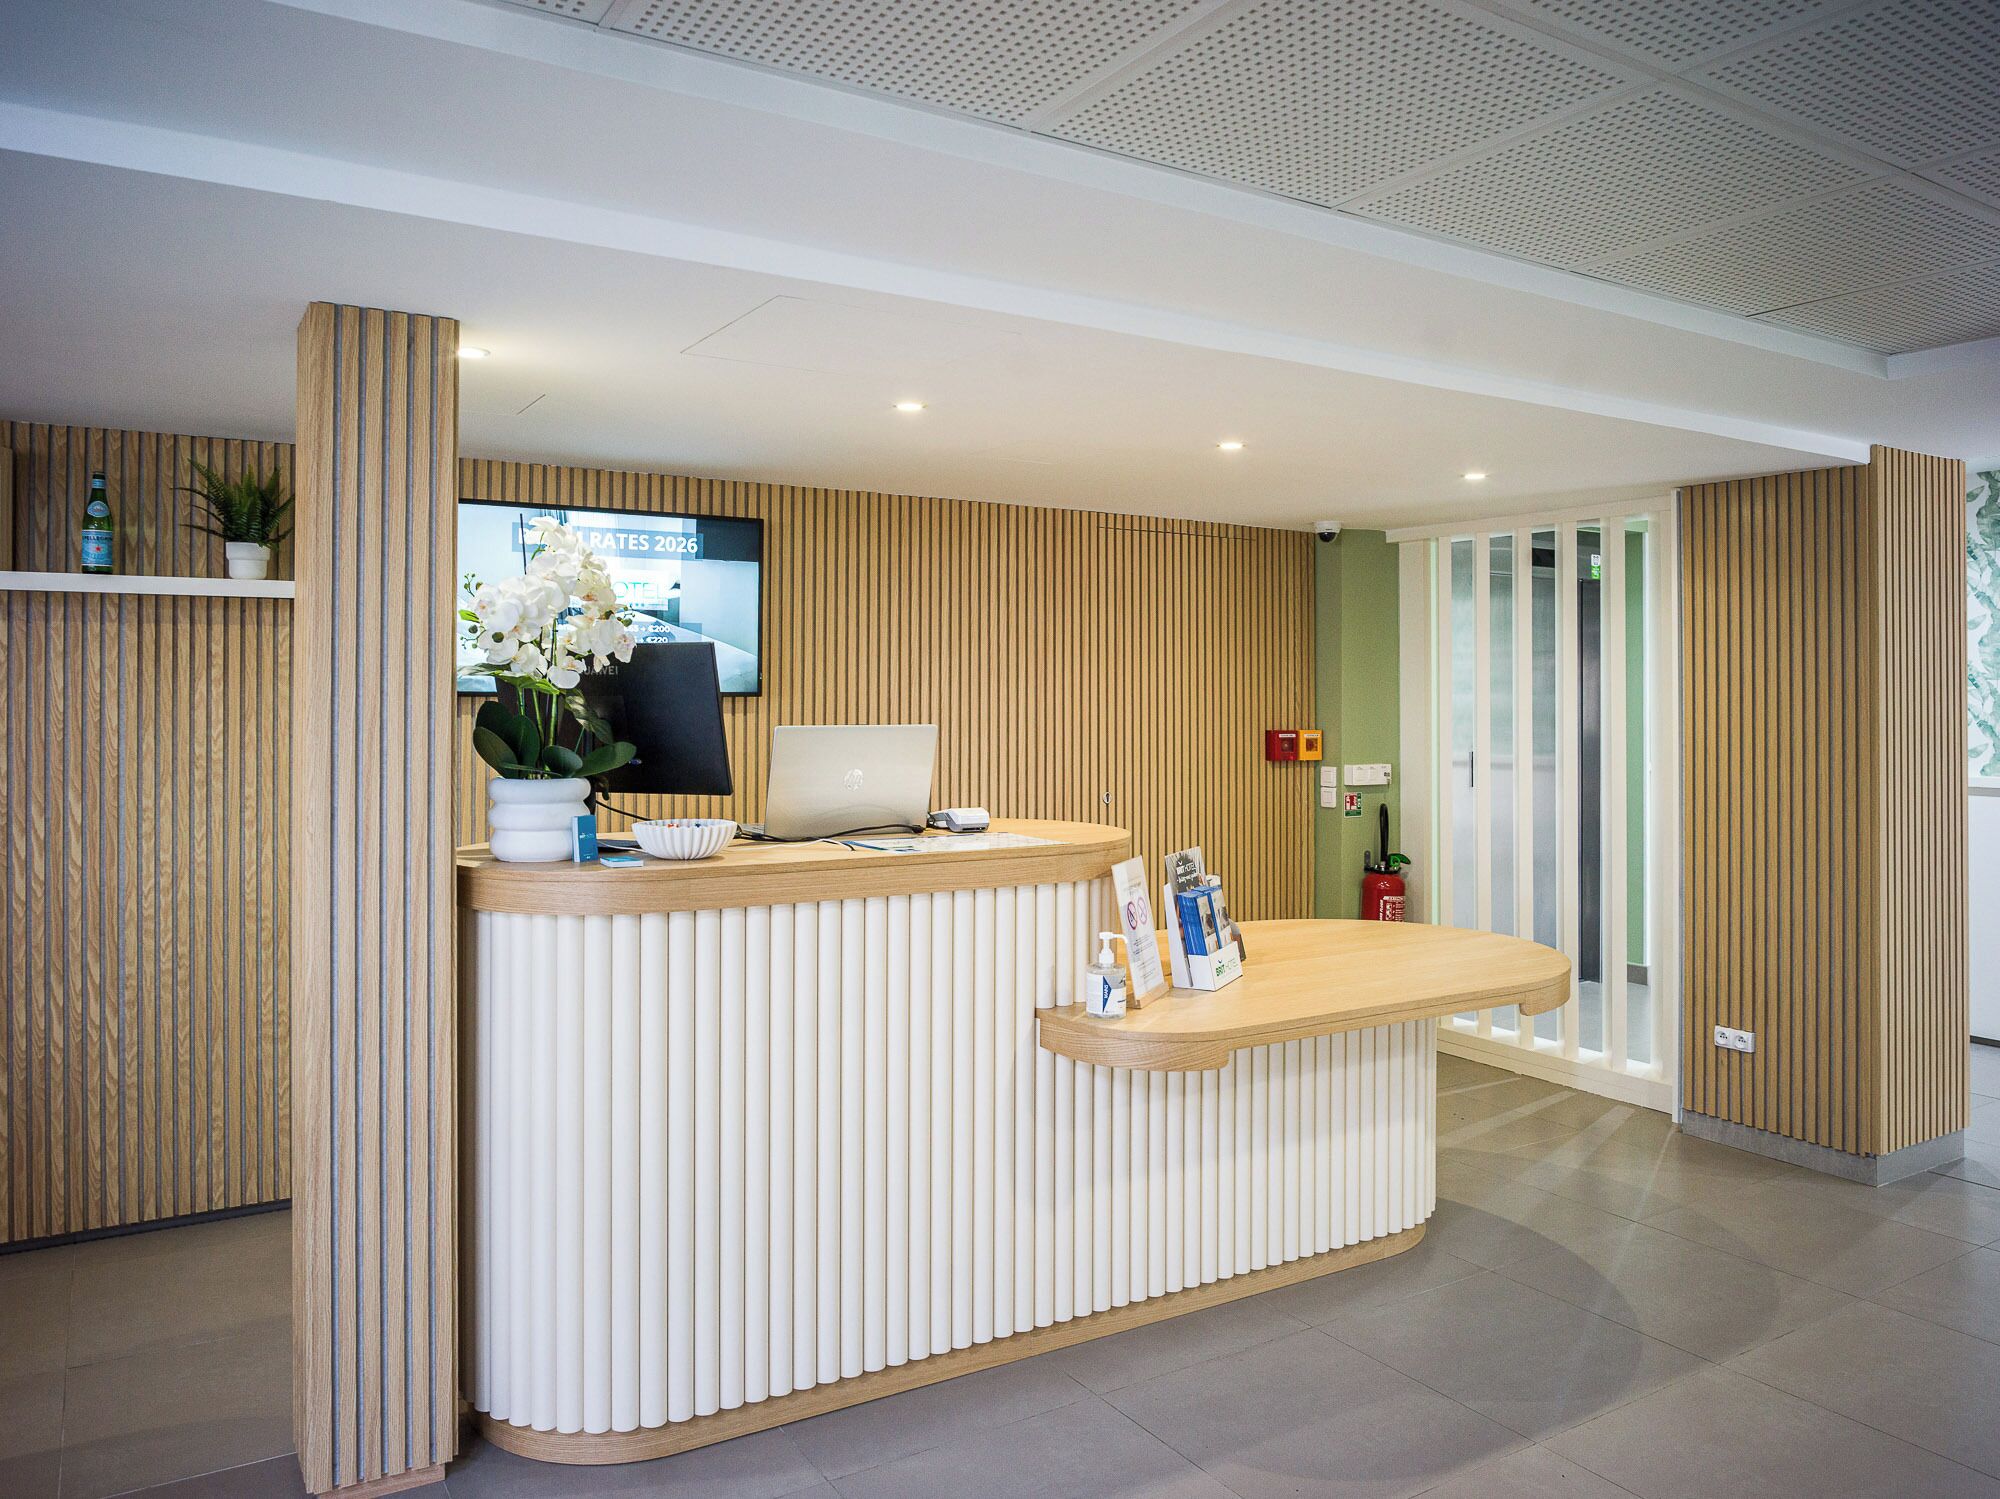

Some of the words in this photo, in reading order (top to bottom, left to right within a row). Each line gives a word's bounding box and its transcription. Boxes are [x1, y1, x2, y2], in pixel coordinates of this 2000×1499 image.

[589, 532, 650, 551] RATES
[654, 535, 698, 553] 2026
[612, 581, 667, 599] OTEL
[584, 665, 618, 676] UAWEI
